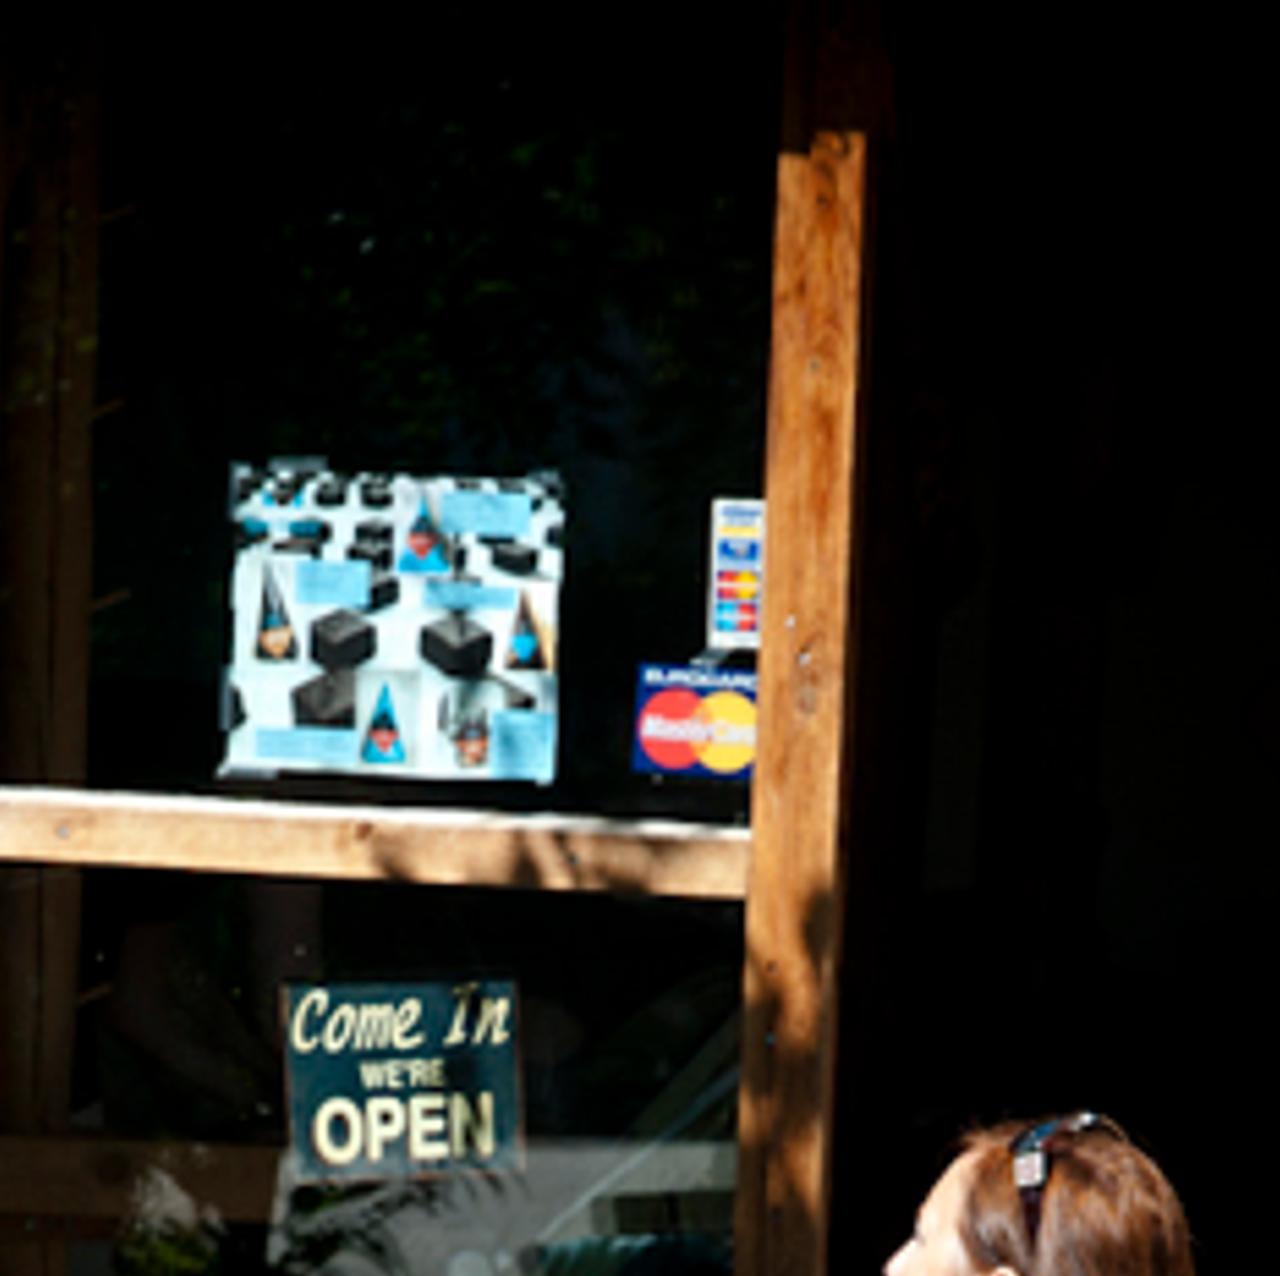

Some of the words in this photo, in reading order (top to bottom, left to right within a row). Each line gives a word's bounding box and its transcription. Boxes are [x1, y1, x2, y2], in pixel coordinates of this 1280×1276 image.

[641, 714, 756, 747] MasterCar
[291, 988, 425, 1053] Come
[443, 983, 510, 1046] In
[360, 1058, 444, 1089] WE'RE
[313, 1091, 496, 1167] OPEN
